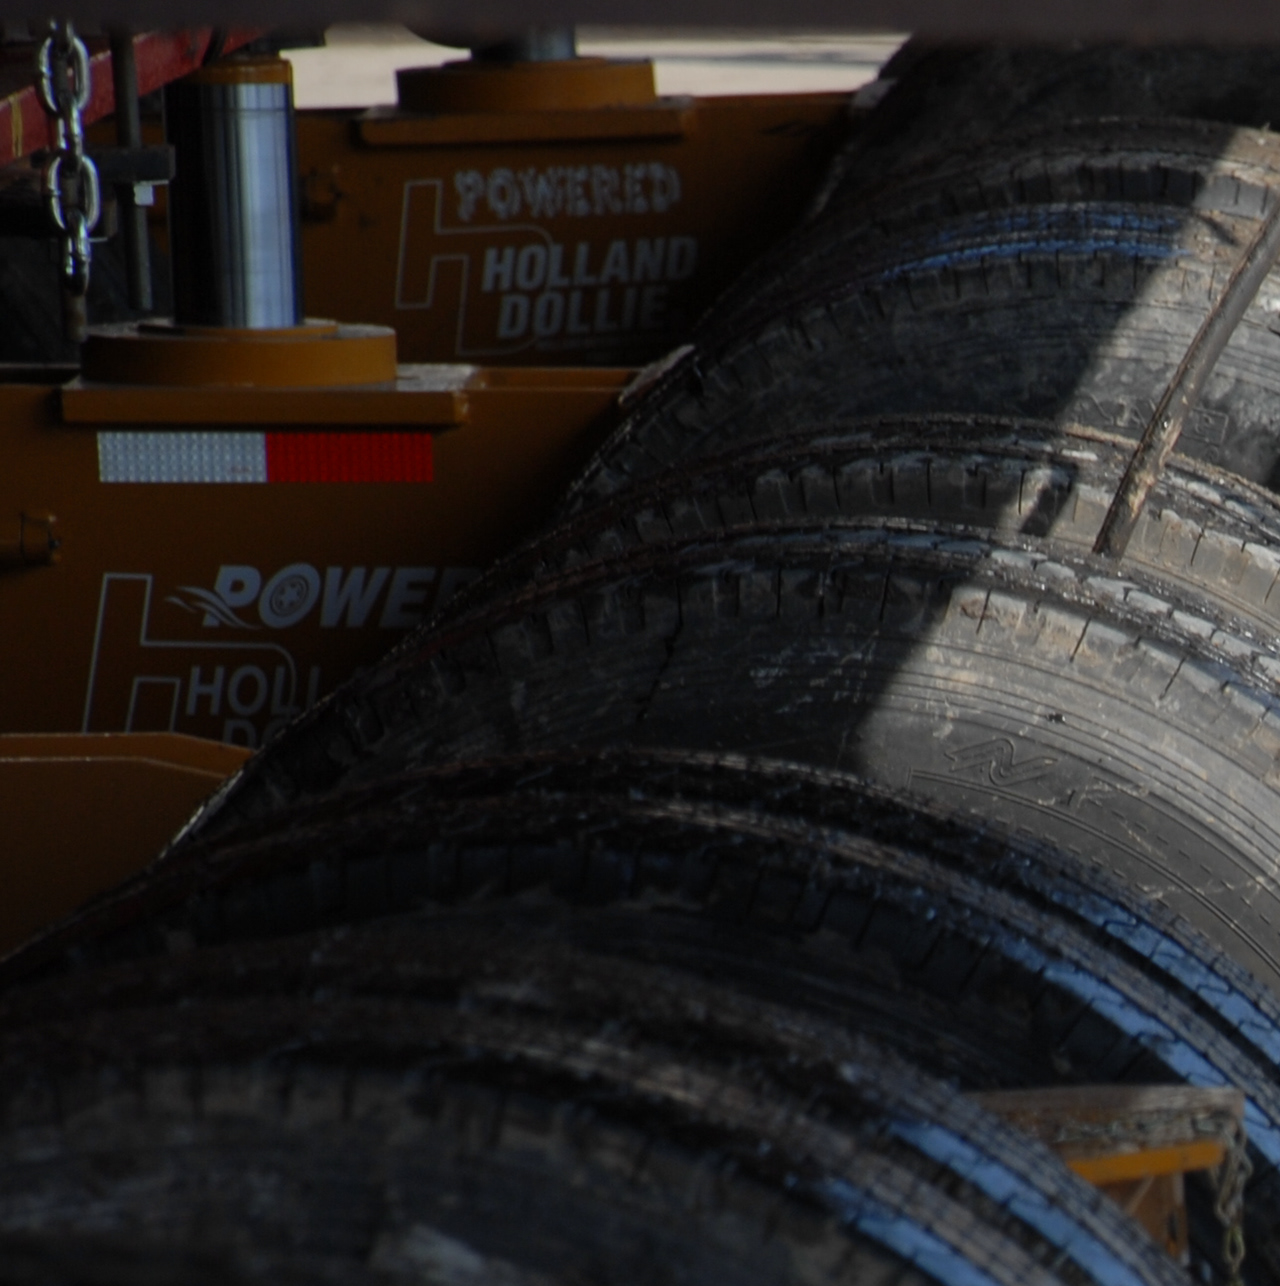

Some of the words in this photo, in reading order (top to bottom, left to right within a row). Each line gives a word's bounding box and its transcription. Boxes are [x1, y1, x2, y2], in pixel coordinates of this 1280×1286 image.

[454, 162, 681, 221] POWERED
[482, 236, 697, 291] HOLLAND
[497, 285, 668, 338] DOLLIE
